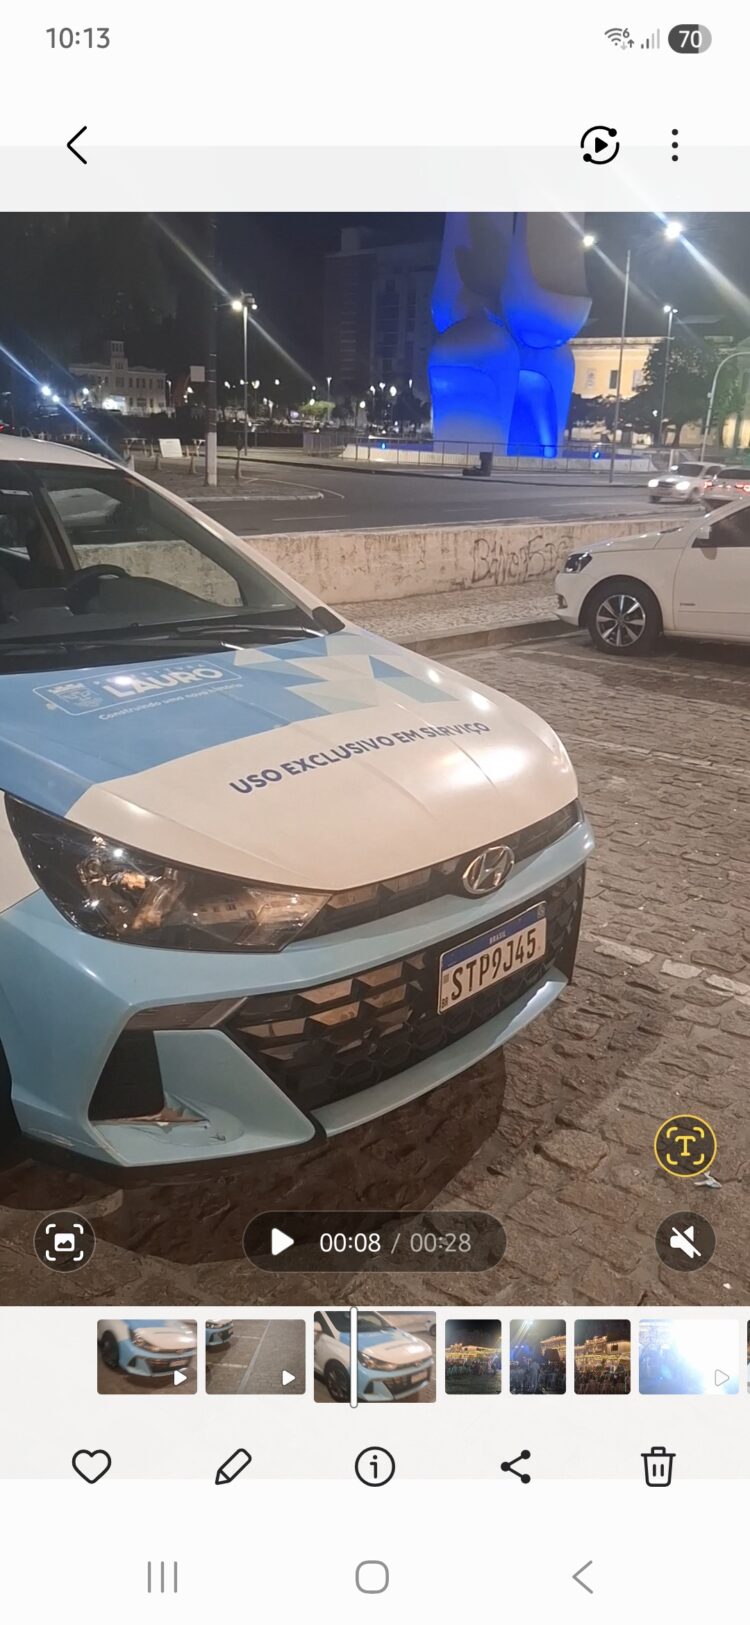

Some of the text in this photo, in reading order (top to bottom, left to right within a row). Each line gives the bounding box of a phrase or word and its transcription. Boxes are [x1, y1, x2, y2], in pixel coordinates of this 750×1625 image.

[102, 668, 223, 698] LAURO
[229, 721, 490, 794] USO EXCLUSIVO EM SERVIÇO
[489, 931, 506, 945] BRASIL
[451, 928, 536, 1000] STP9J45
